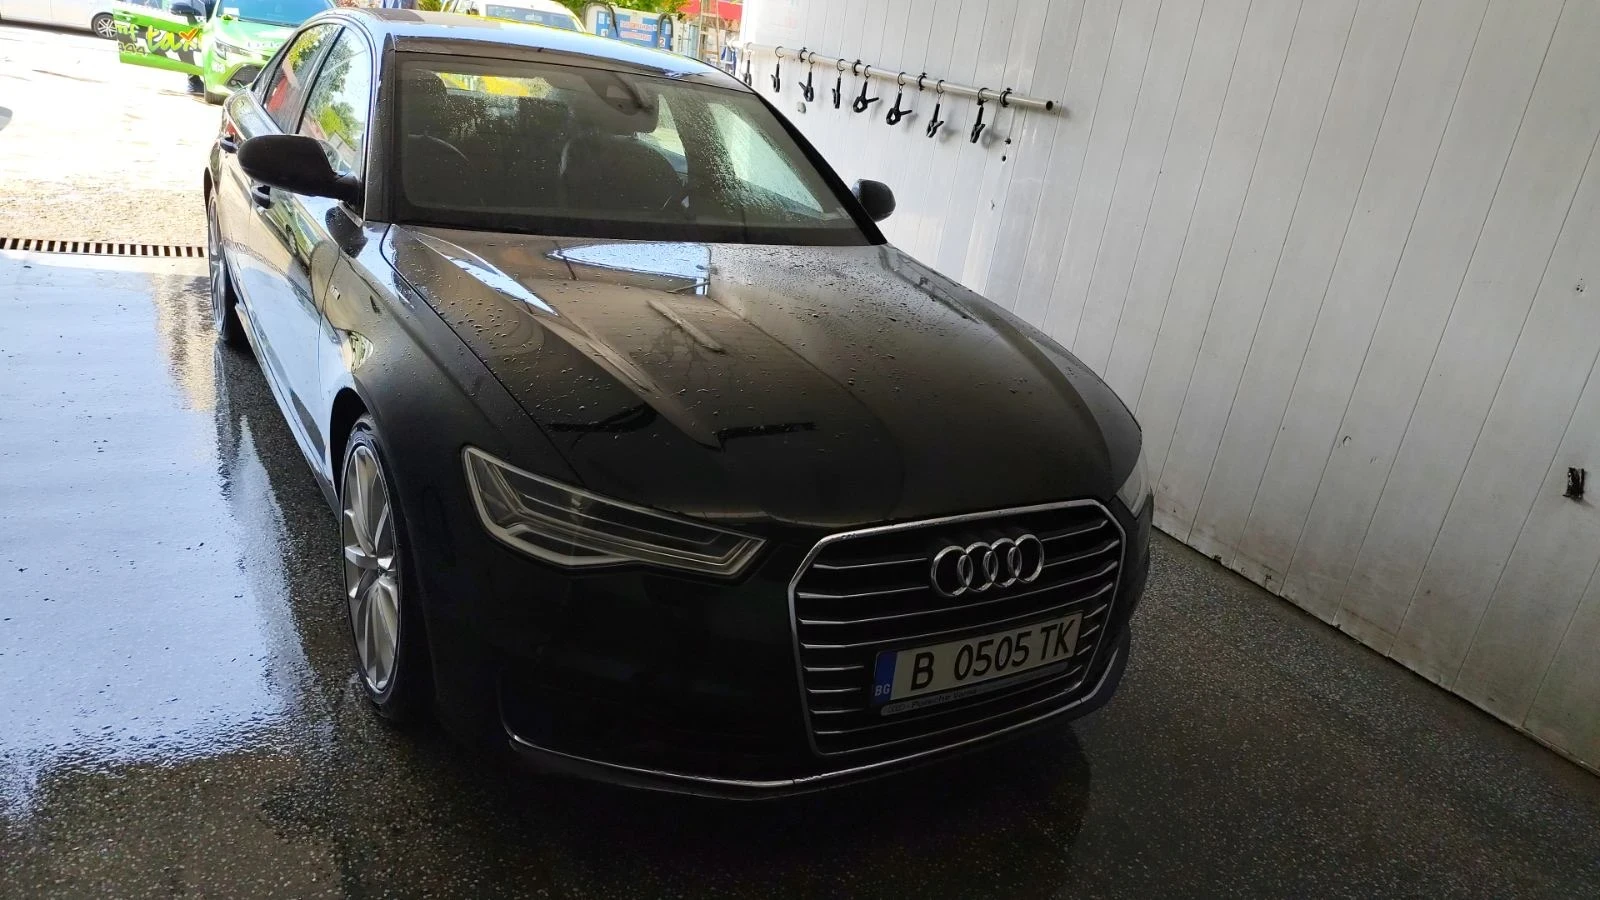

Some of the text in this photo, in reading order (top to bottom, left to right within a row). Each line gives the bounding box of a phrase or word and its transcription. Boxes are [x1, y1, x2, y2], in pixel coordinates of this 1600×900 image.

[910, 619, 1075, 691] B 0505 TK
[874, 683, 891, 696] BG
